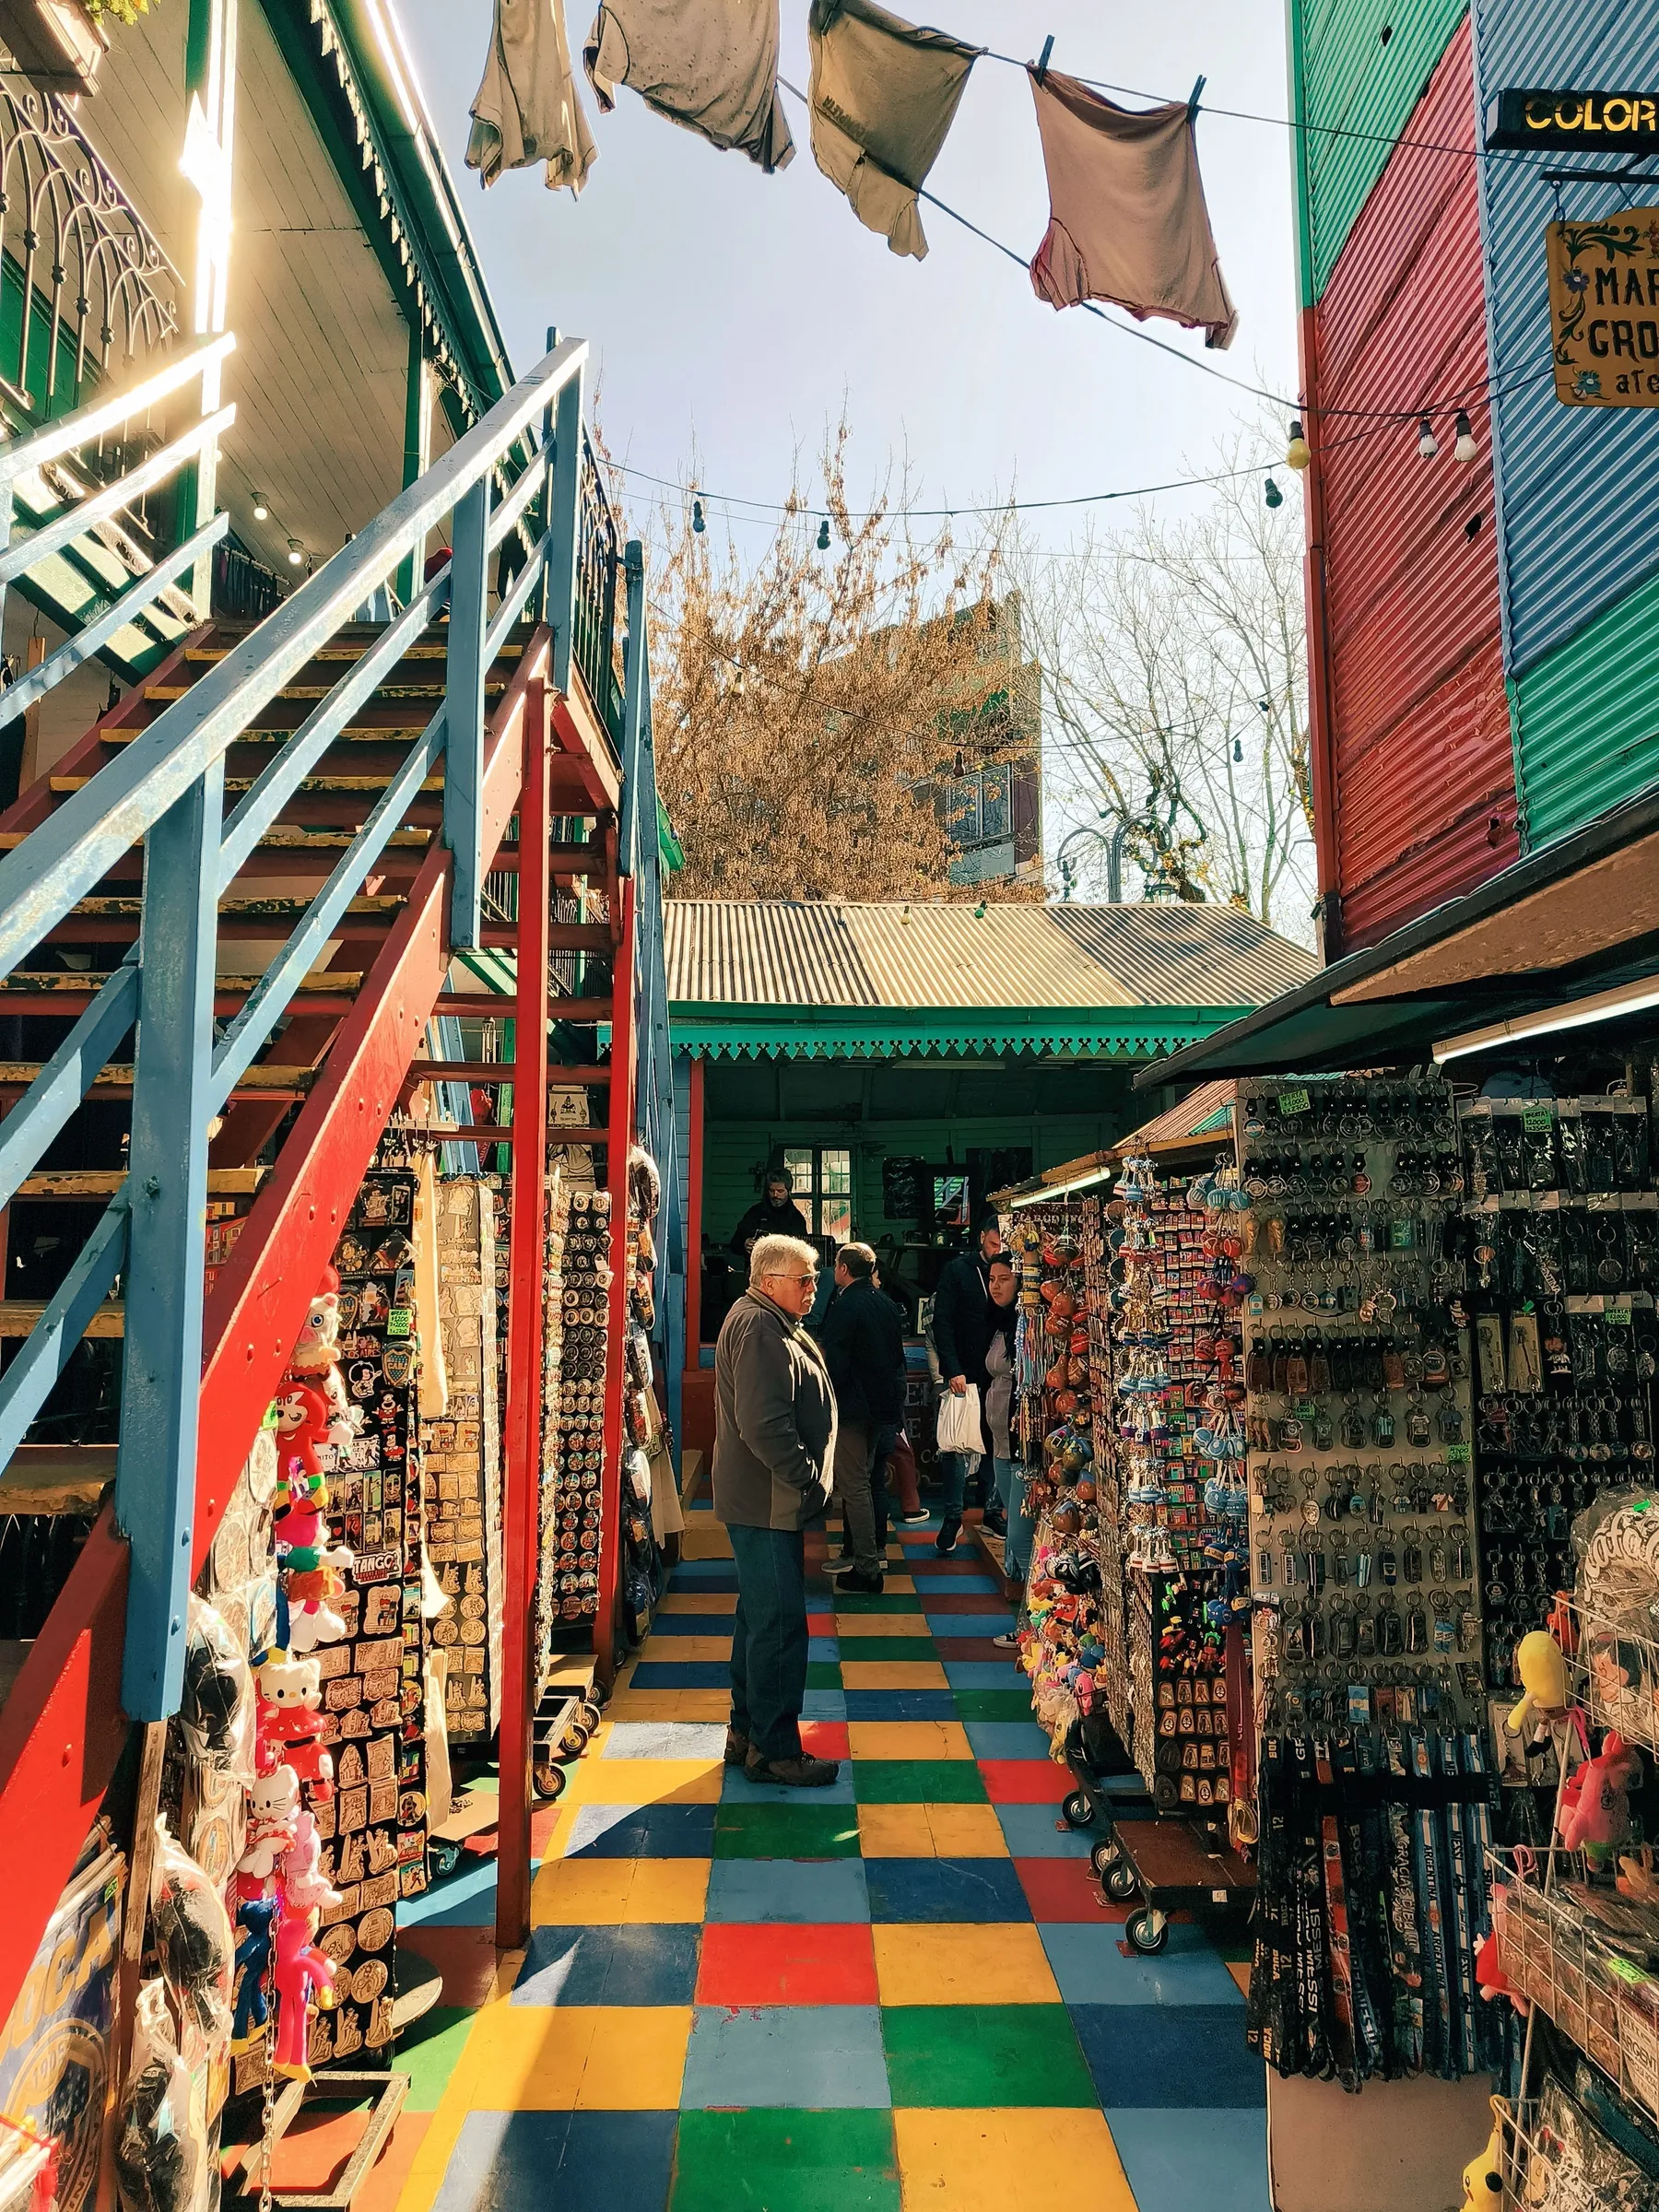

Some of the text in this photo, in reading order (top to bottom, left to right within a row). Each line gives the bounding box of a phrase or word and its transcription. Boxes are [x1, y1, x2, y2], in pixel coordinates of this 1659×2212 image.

[1524, 99, 1655, 131] COLOR
[1451, 1830, 1465, 1861] MESSI
[1424, 1844, 1437, 1901] ARGENTINA
[1310, 1908, 1323, 1970] MESSI
[1432, 1931, 1445, 1990] ARGENTINA
[1459, 1948, 1470, 1979] MESSI
[0, 1904, 112, 2061] OCA
[1248, 2030, 1259, 2043] 12
[1263, 2027, 1273, 2060] BOCA
[32, 2042, 66, 2088] 1905
